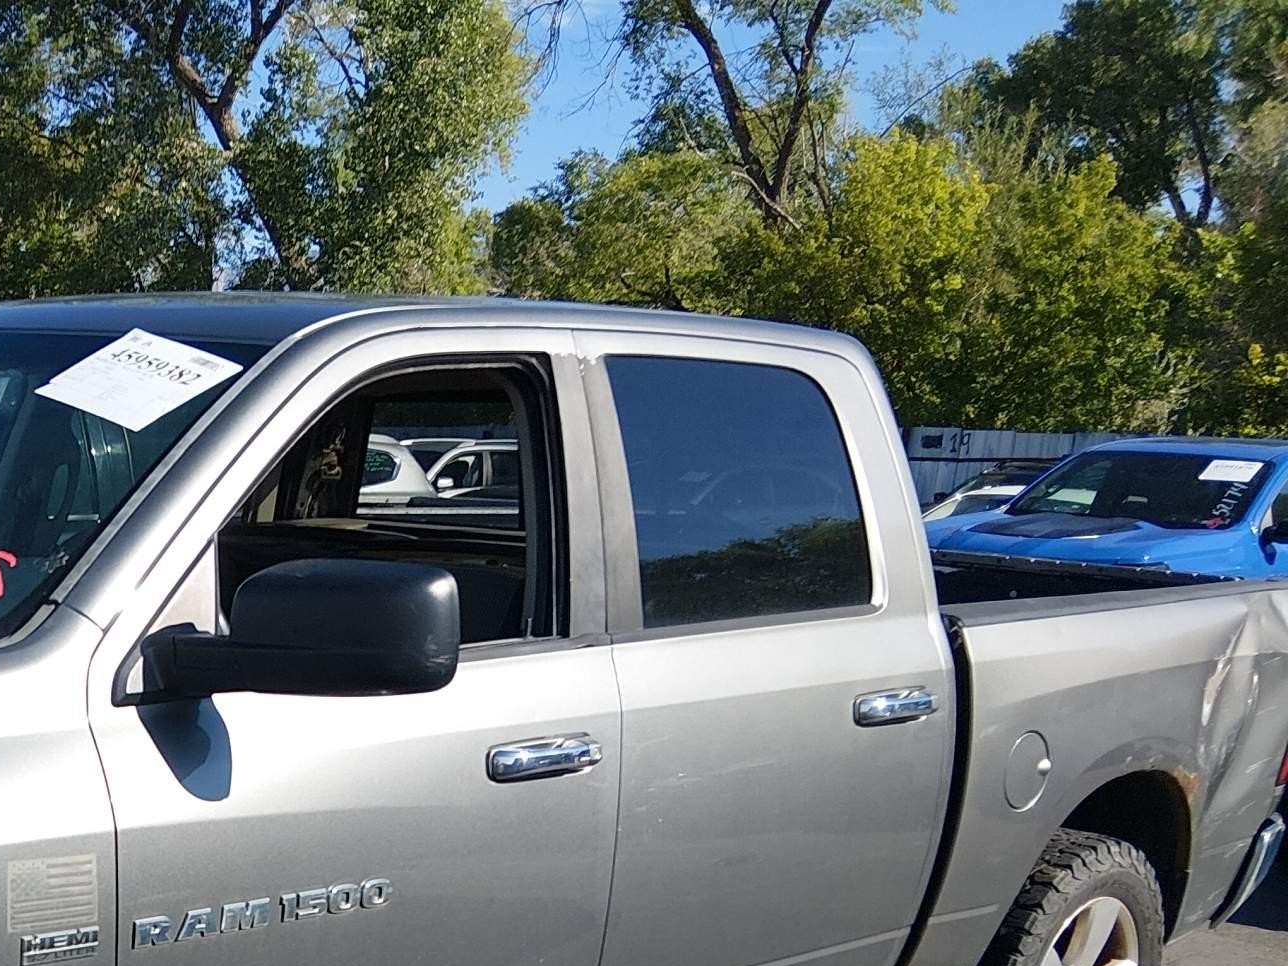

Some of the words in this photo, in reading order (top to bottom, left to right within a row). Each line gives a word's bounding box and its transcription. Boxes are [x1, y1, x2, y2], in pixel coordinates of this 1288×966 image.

[131, 896, 270, 950] RAM
[279, 878, 393, 923] 1500
[21, 926, 99, 955] HEMI
